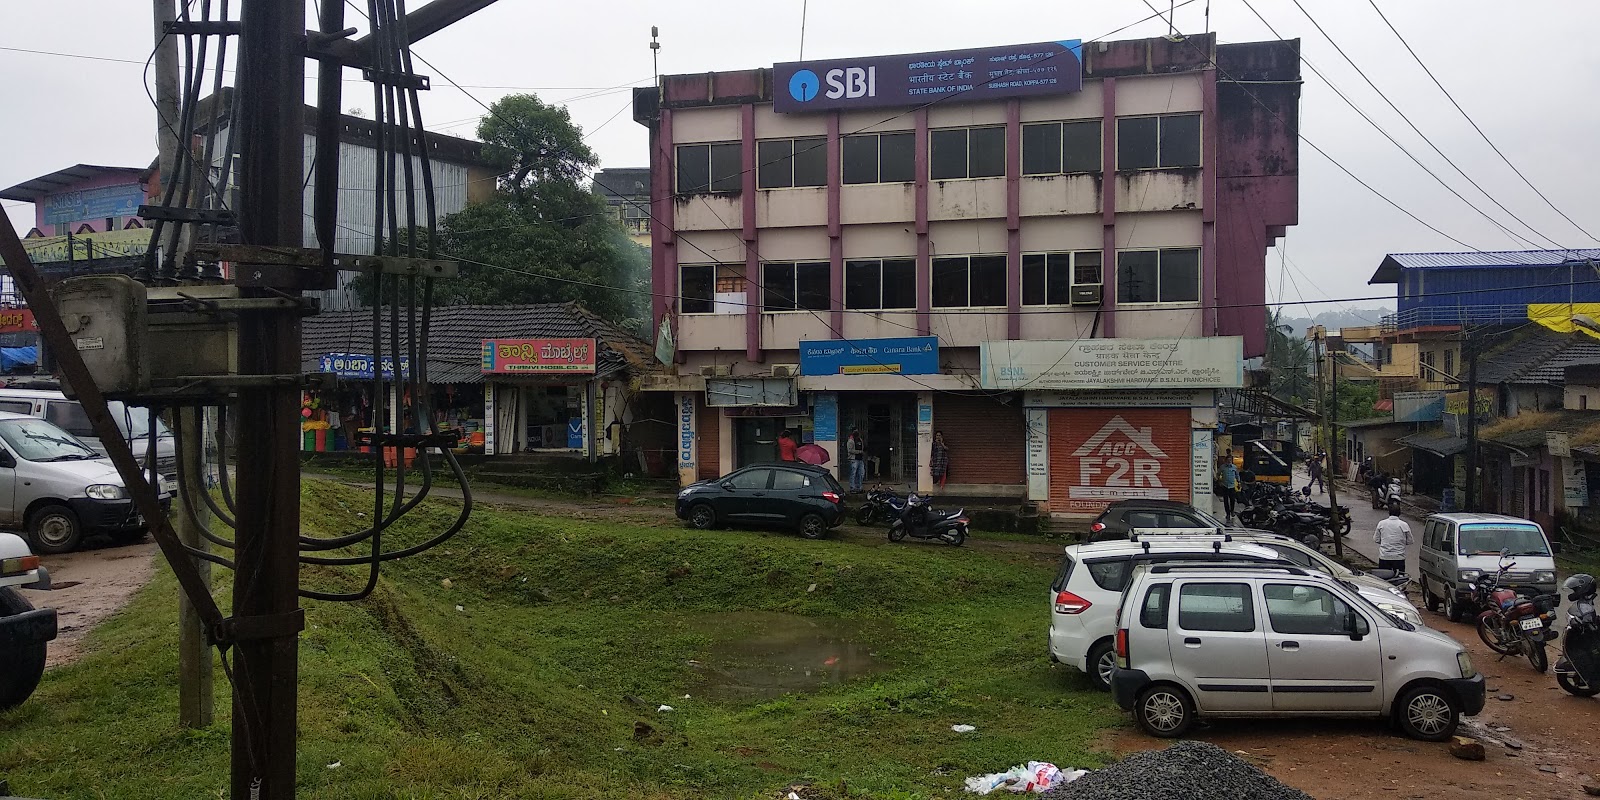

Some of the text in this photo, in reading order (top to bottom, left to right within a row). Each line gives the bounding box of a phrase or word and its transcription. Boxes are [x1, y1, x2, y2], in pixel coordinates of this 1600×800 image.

[908, 60, 935, 70] ಭಾರತೀಯ
[825, 66, 876, 99] SBI
[909, 70, 973, 83] भारतीय स्टेट बैंक
[1000, 367, 1025, 375] BSNL
[1097, 442, 1137, 456] ACC
[1080, 457, 1163, 487] F2R
